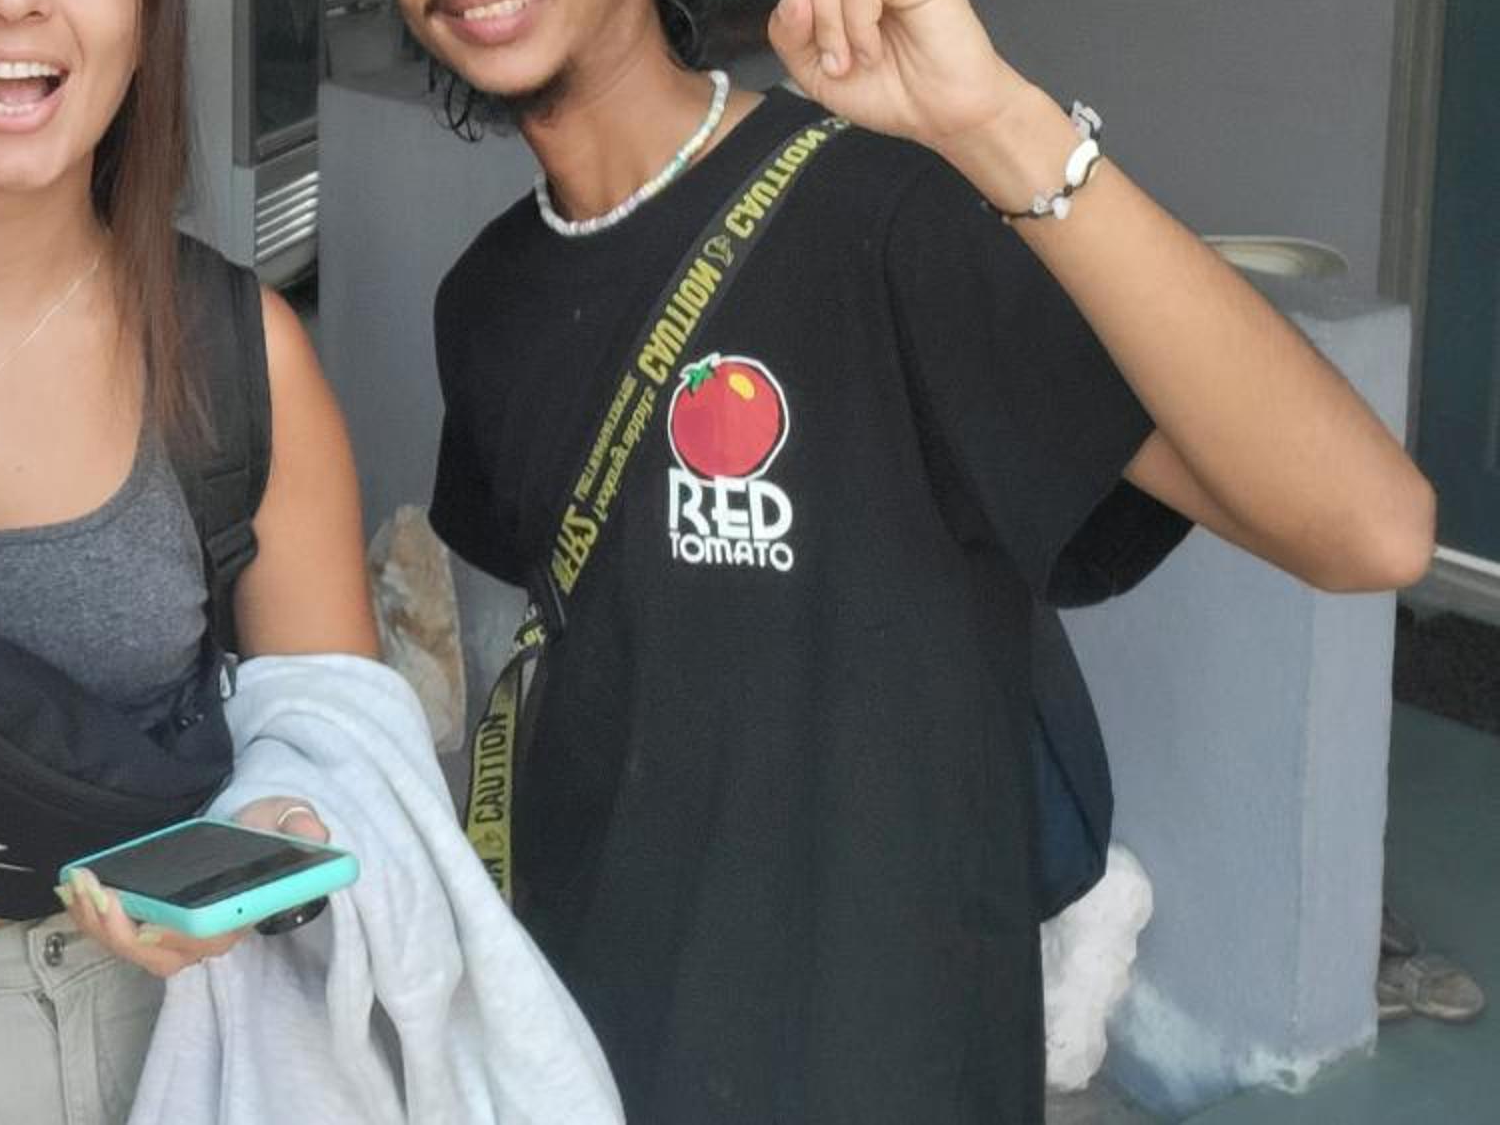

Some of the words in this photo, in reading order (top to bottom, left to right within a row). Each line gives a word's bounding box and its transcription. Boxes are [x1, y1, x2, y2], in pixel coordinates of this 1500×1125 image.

[668, 467, 793, 540] RED
[668, 531, 794, 572] TOMATO
[474, 712, 508, 824] CAUTION
